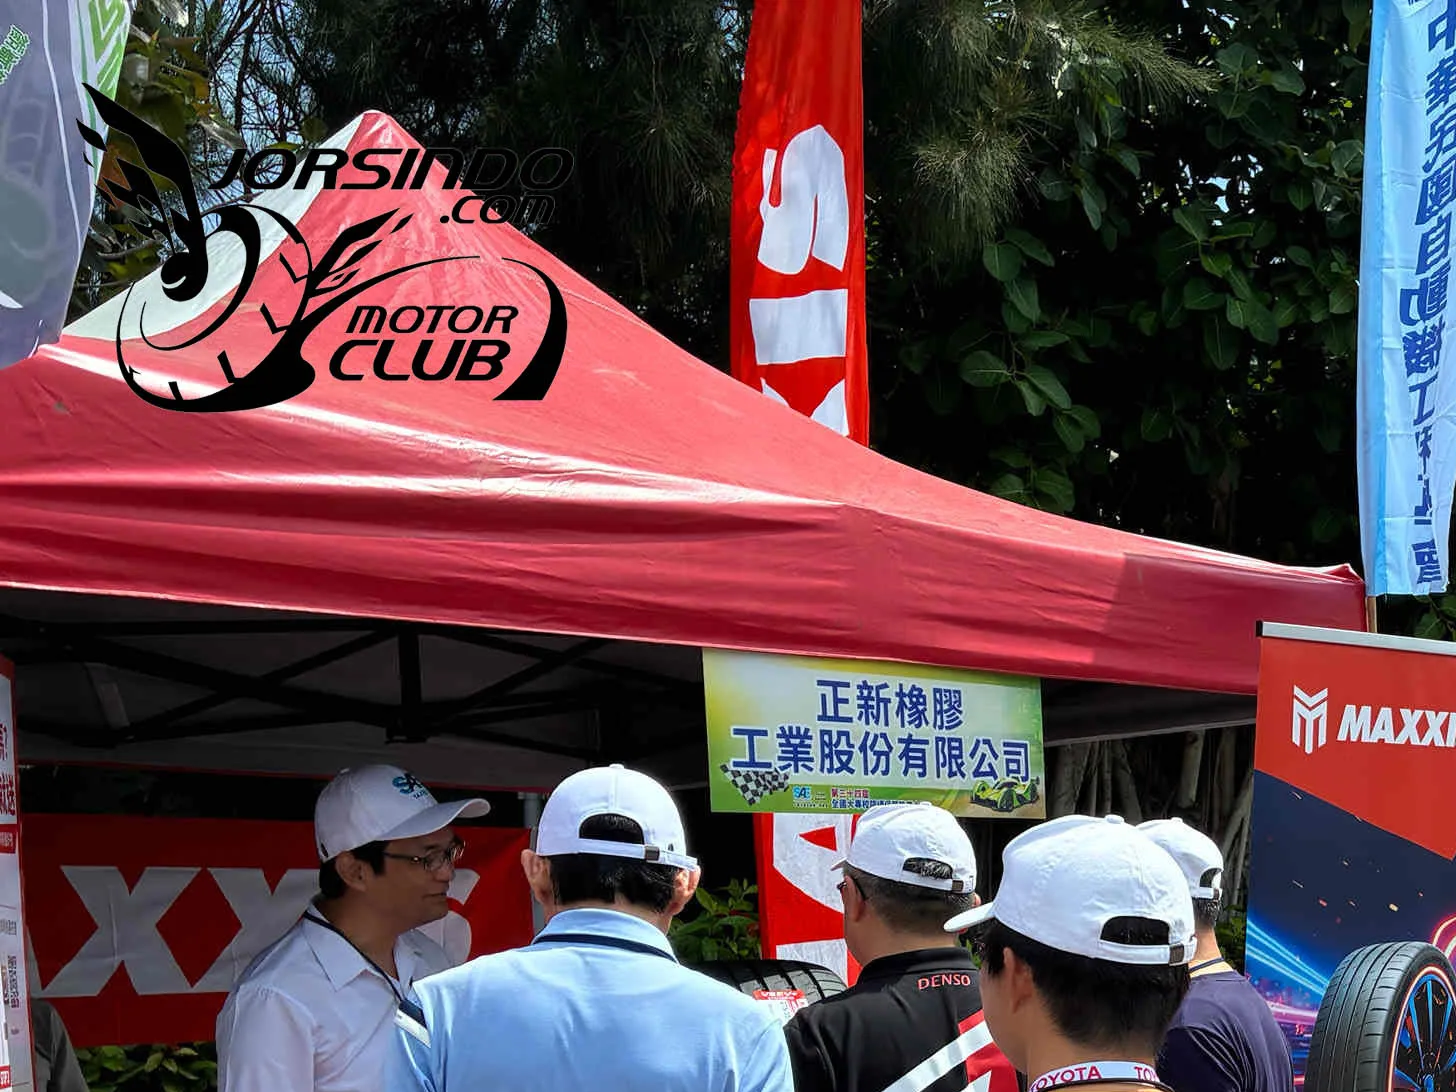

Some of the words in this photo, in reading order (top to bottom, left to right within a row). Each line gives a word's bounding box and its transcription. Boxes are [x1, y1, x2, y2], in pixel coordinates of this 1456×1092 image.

[816, 679, 964, 731] 正新橡膠
[732, 725, 1030, 783] 工業股份有限公司
[917, 974, 971, 990] DENSO
